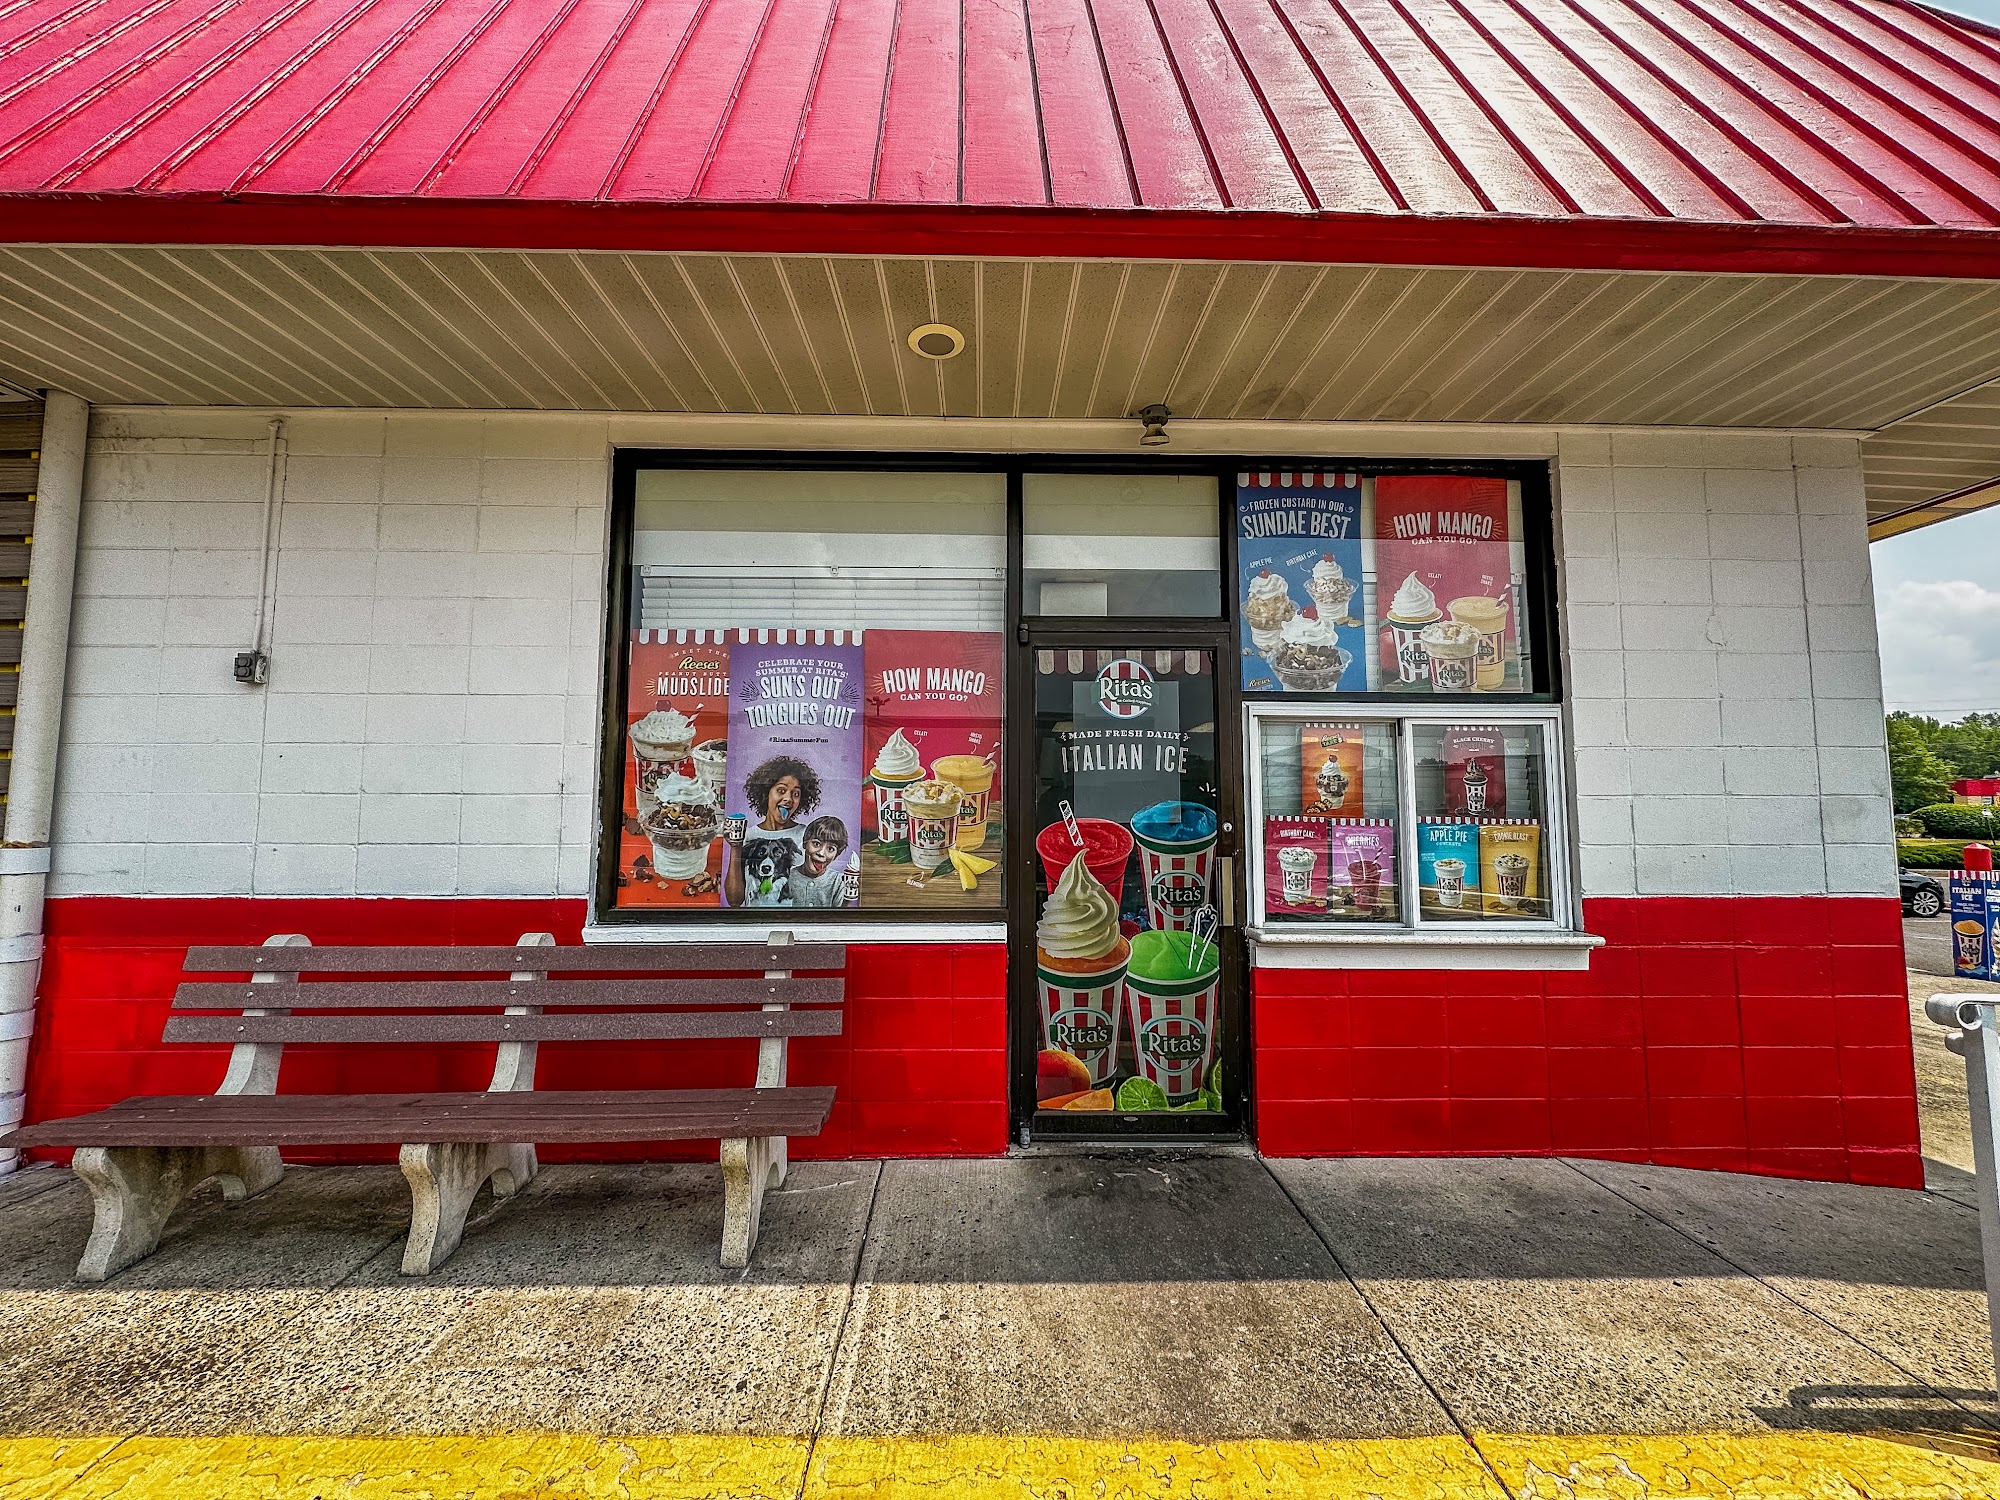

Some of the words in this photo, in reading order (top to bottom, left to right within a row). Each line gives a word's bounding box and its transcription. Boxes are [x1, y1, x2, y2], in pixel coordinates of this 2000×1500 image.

[1249, 498, 1280, 512] FROZEN
[1281, 497, 1316, 509] CUSTARD
[1318, 499, 1327, 510] IN
[1328, 500, 1345, 513] OUR
[1241, 510, 1307, 540] SUNDAE
[1310, 511, 1352, 540] BEST
[1393, 512, 1431, 539] HOW
[1437, 511, 1493, 539] MANGO
[1411, 537, 1433, 545] CAN
[1459, 537, 1477, 545] GO?
[1249, 559, 1265, 569] APPLE
[1265, 556, 1273, 565] PIE
[1285, 553, 1307, 567] BIRTHDAY
[1306, 548, 1318, 560] CAKE
[674, 648, 701, 657] MEET
[708, 649, 727, 657] THE
[1404, 650, 1427, 661] Rita
[678, 656, 720, 670] Reese's
[758, 659, 815, 668] CELEBRATE
[817, 659, 844, 670] YOUR
[755, 667, 798, 677] SUMMER
[815, 668, 849, 678] RITA'S!
[1442, 669, 1465, 679] Rita's
[657, 677, 729, 696] MUDSLIDE
[760, 674, 806, 699] SUN'S
[810, 675, 843, 700] OUT
[882, 667, 921, 694] HOW
[926, 667, 986, 696] MANGO
[1100, 677, 1153, 701] Rita's
[900, 693, 921, 701] CAN
[949, 694, 968, 703] GO?
[744, 702, 818, 730] TONGUES
[823, 703, 856, 730] OUT
[1068, 730, 1102, 740] MADE
[1105, 730, 1144, 738] FRESH
[1146, 730, 1181, 740] DAILY
[1061, 743, 1143, 773] ITALIAN
[1155, 744, 1189, 774] ICE
[884, 808, 907, 820] Rita
[921, 829, 944, 840] Rita's
[1430, 830, 1453, 842] APPLE
[1455, 831, 1468, 843] PIE
[1157, 884, 1201, 904] Rita's
[1057, 1023, 1108, 1046] Rita's
[1149, 1032, 1201, 1056] Rita's
